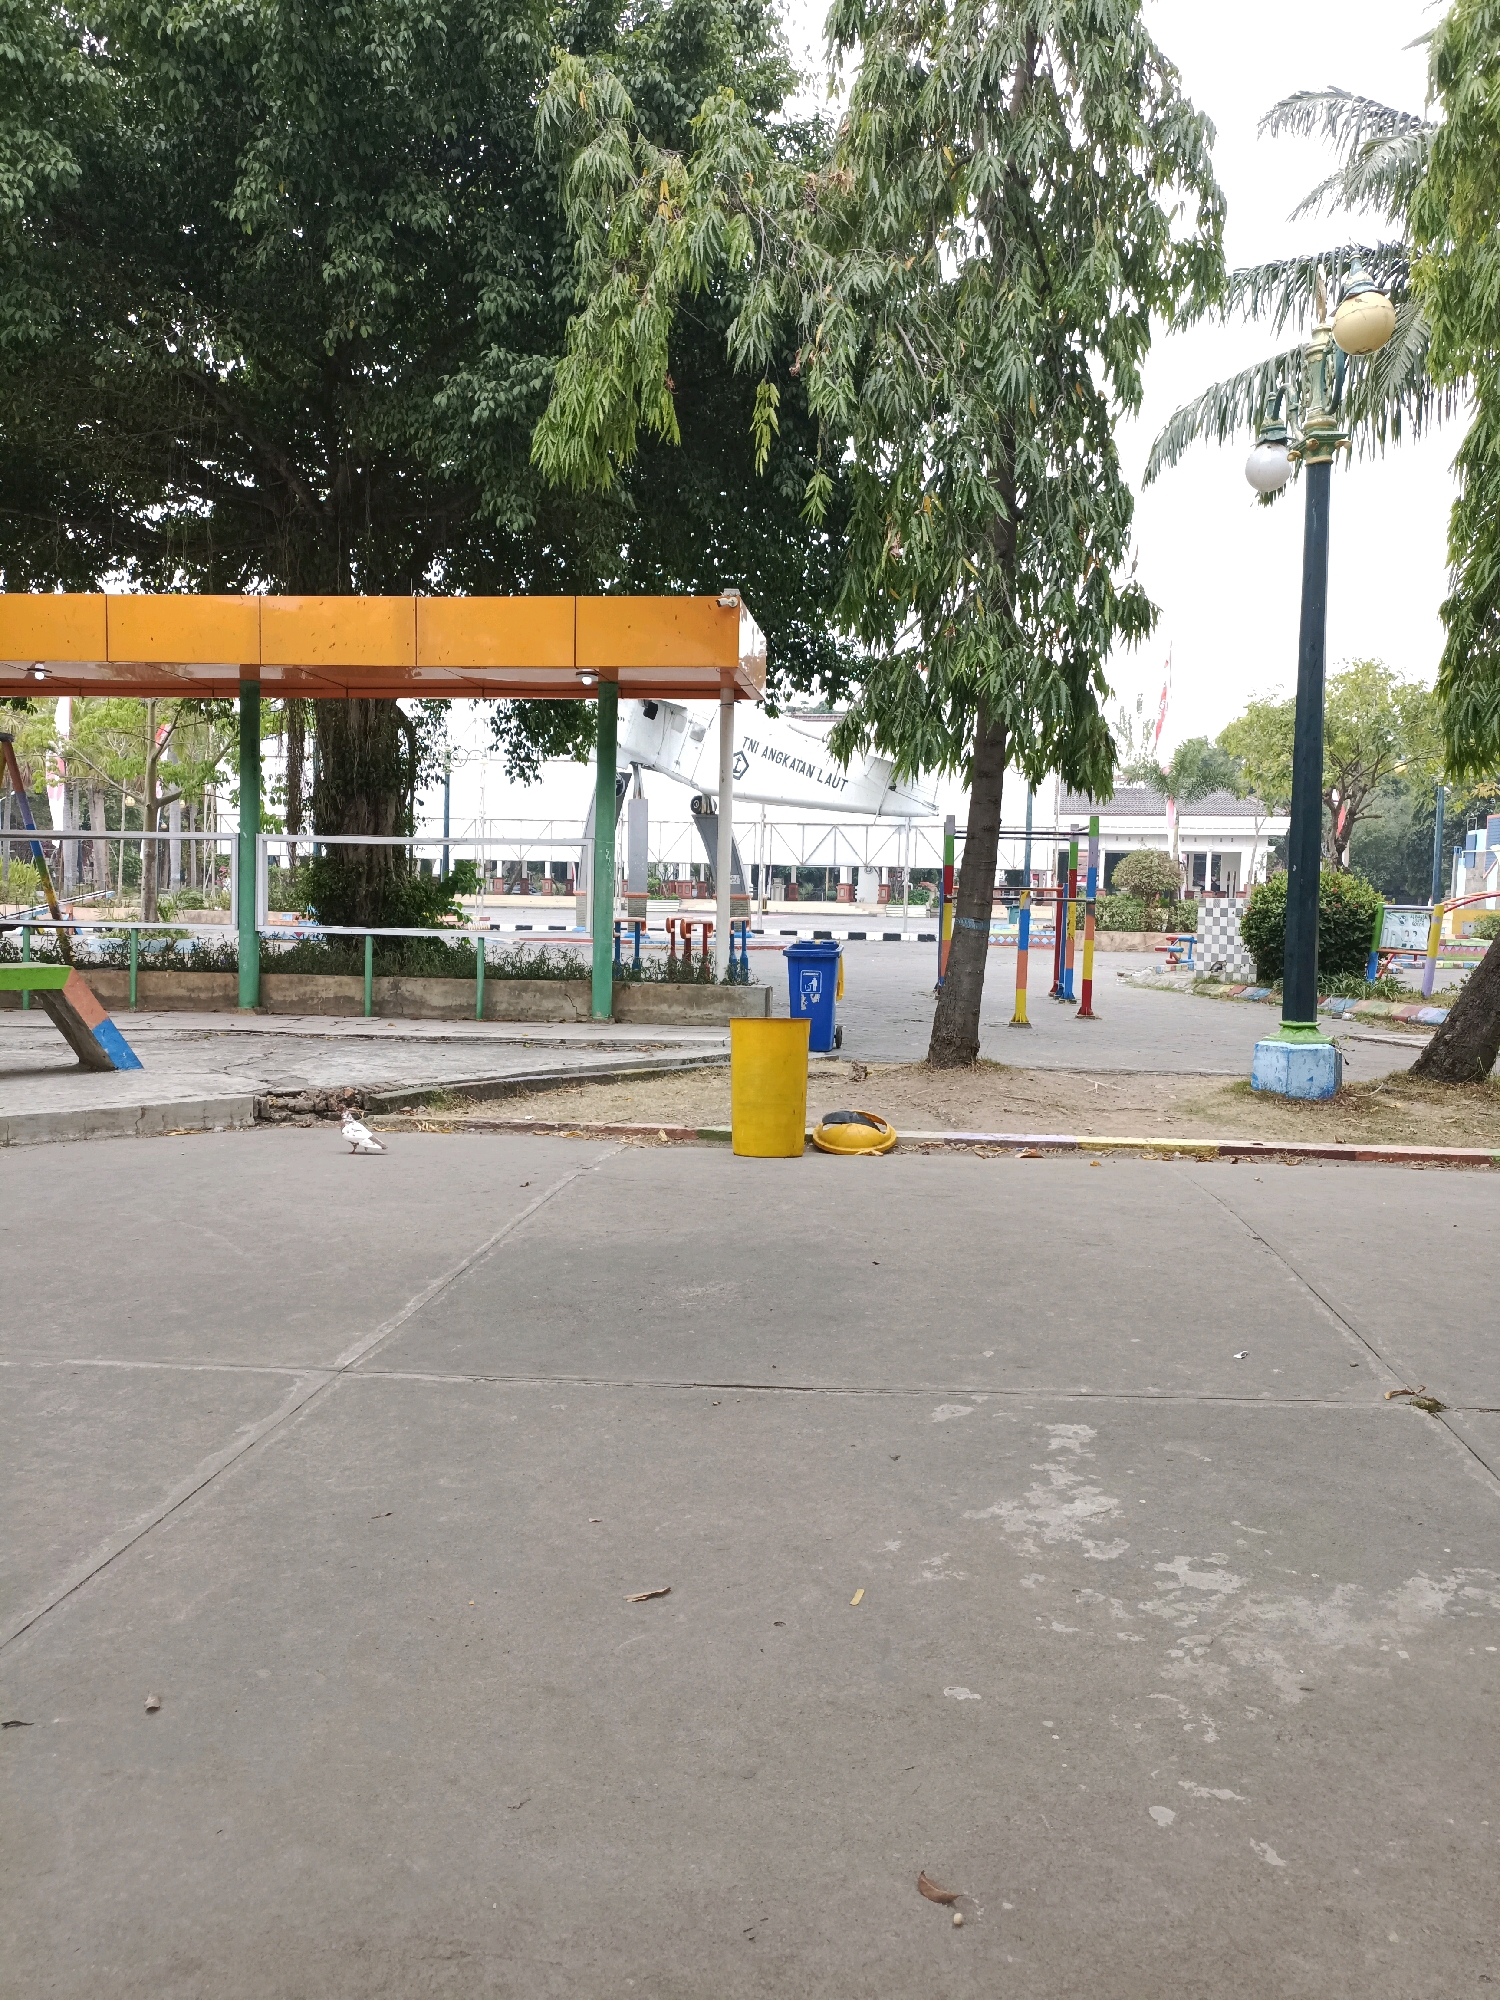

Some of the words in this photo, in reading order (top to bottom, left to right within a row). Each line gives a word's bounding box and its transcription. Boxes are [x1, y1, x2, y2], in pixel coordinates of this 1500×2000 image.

[743, 736, 760, 754] TNI
[761, 746, 816, 778] ANGKATAN
[816, 769, 849, 792] LAUT
